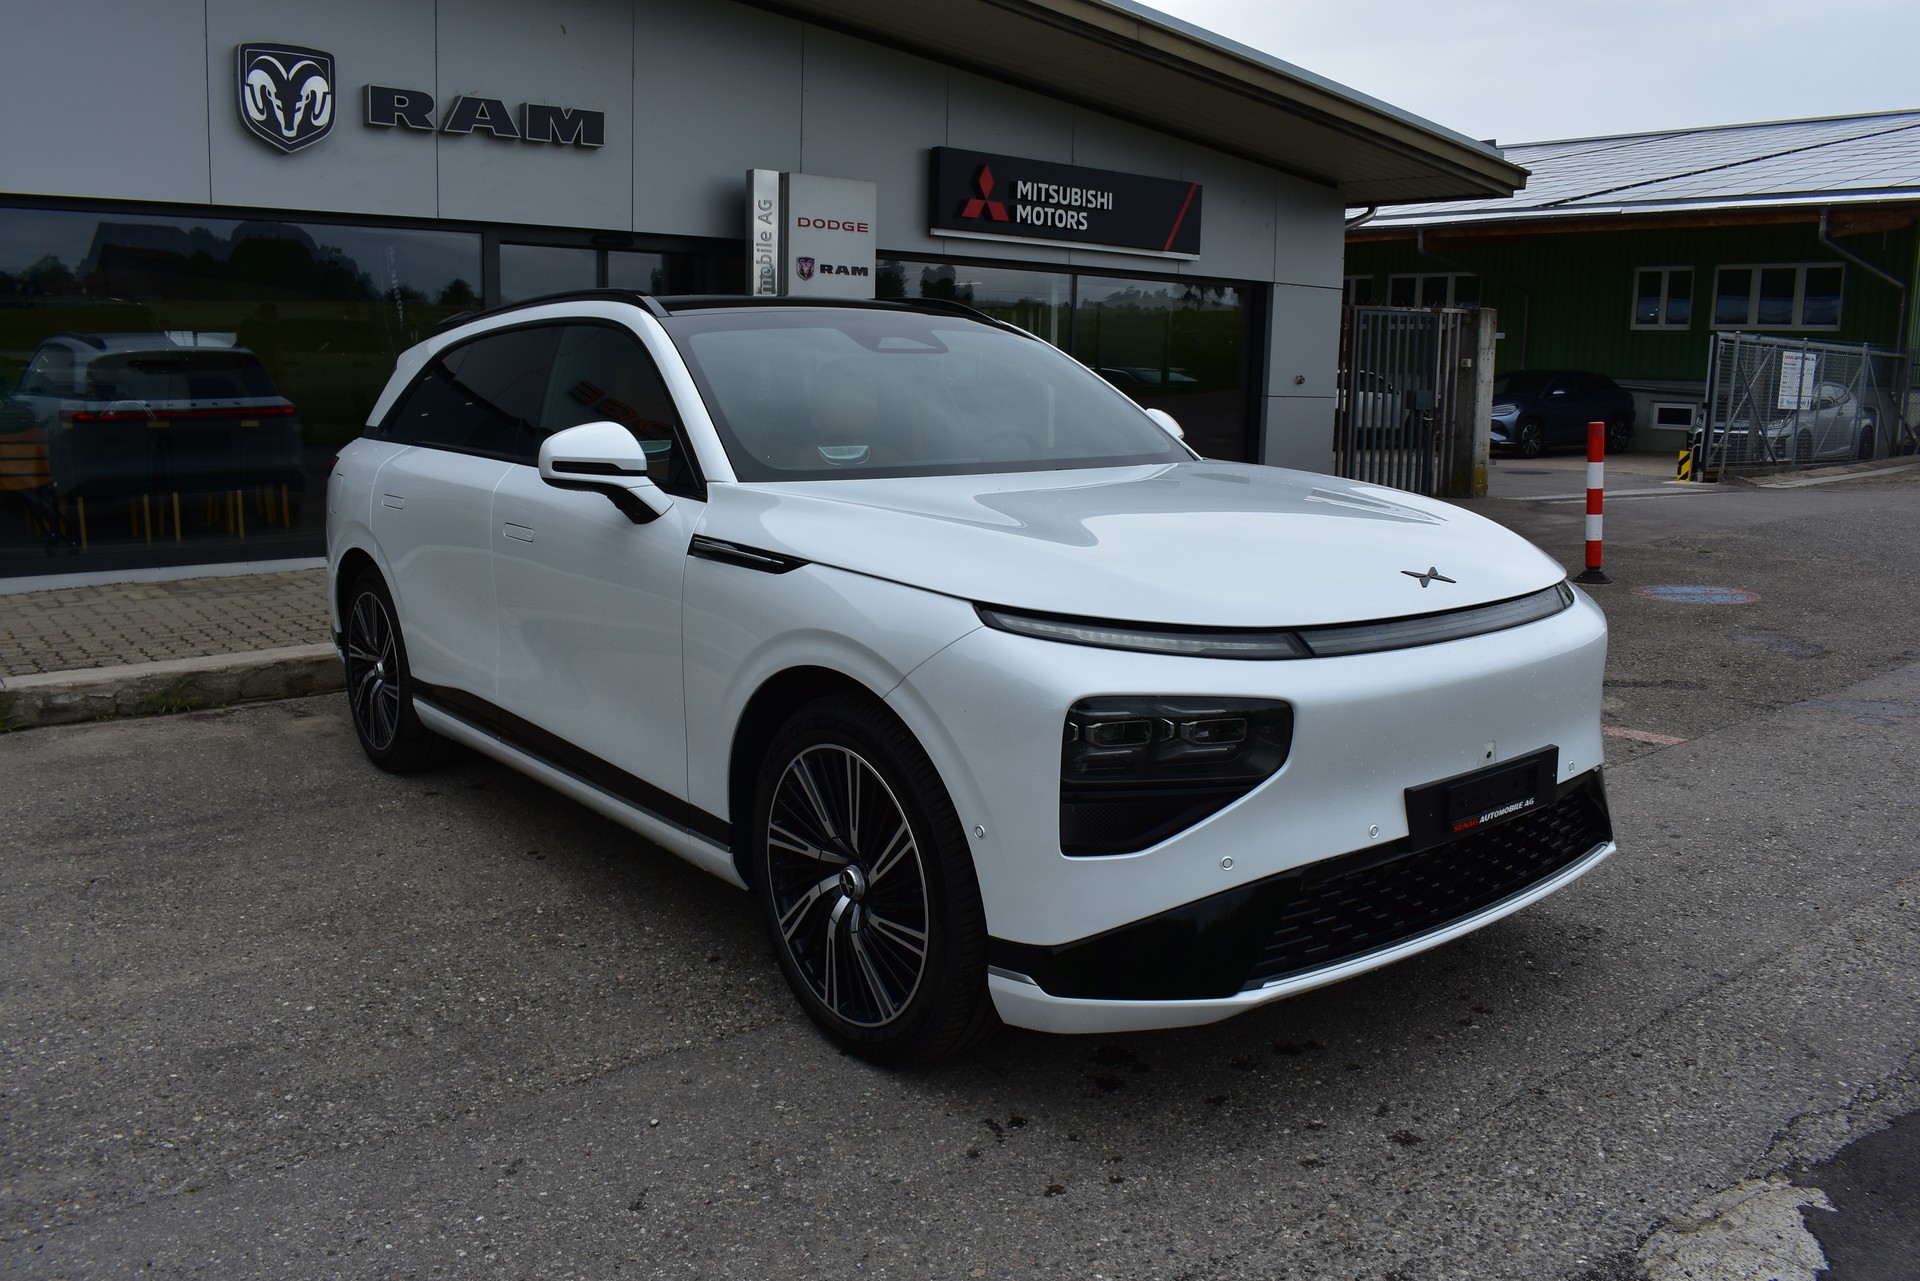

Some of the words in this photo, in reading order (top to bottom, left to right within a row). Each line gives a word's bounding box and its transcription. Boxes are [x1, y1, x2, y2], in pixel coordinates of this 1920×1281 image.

[363, 83, 605, 147] RAM
[1016, 180, 1113, 211] MITSUBISHI
[758, 199, 773, 225] AG
[797, 217, 869, 233] DODGE
[1016, 204, 1088, 231] MOTORS
[820, 264, 869, 276] RAM
[1479, 801, 1524, 823] AUTOMOBILE
[1524, 798, 1534, 807] AG
